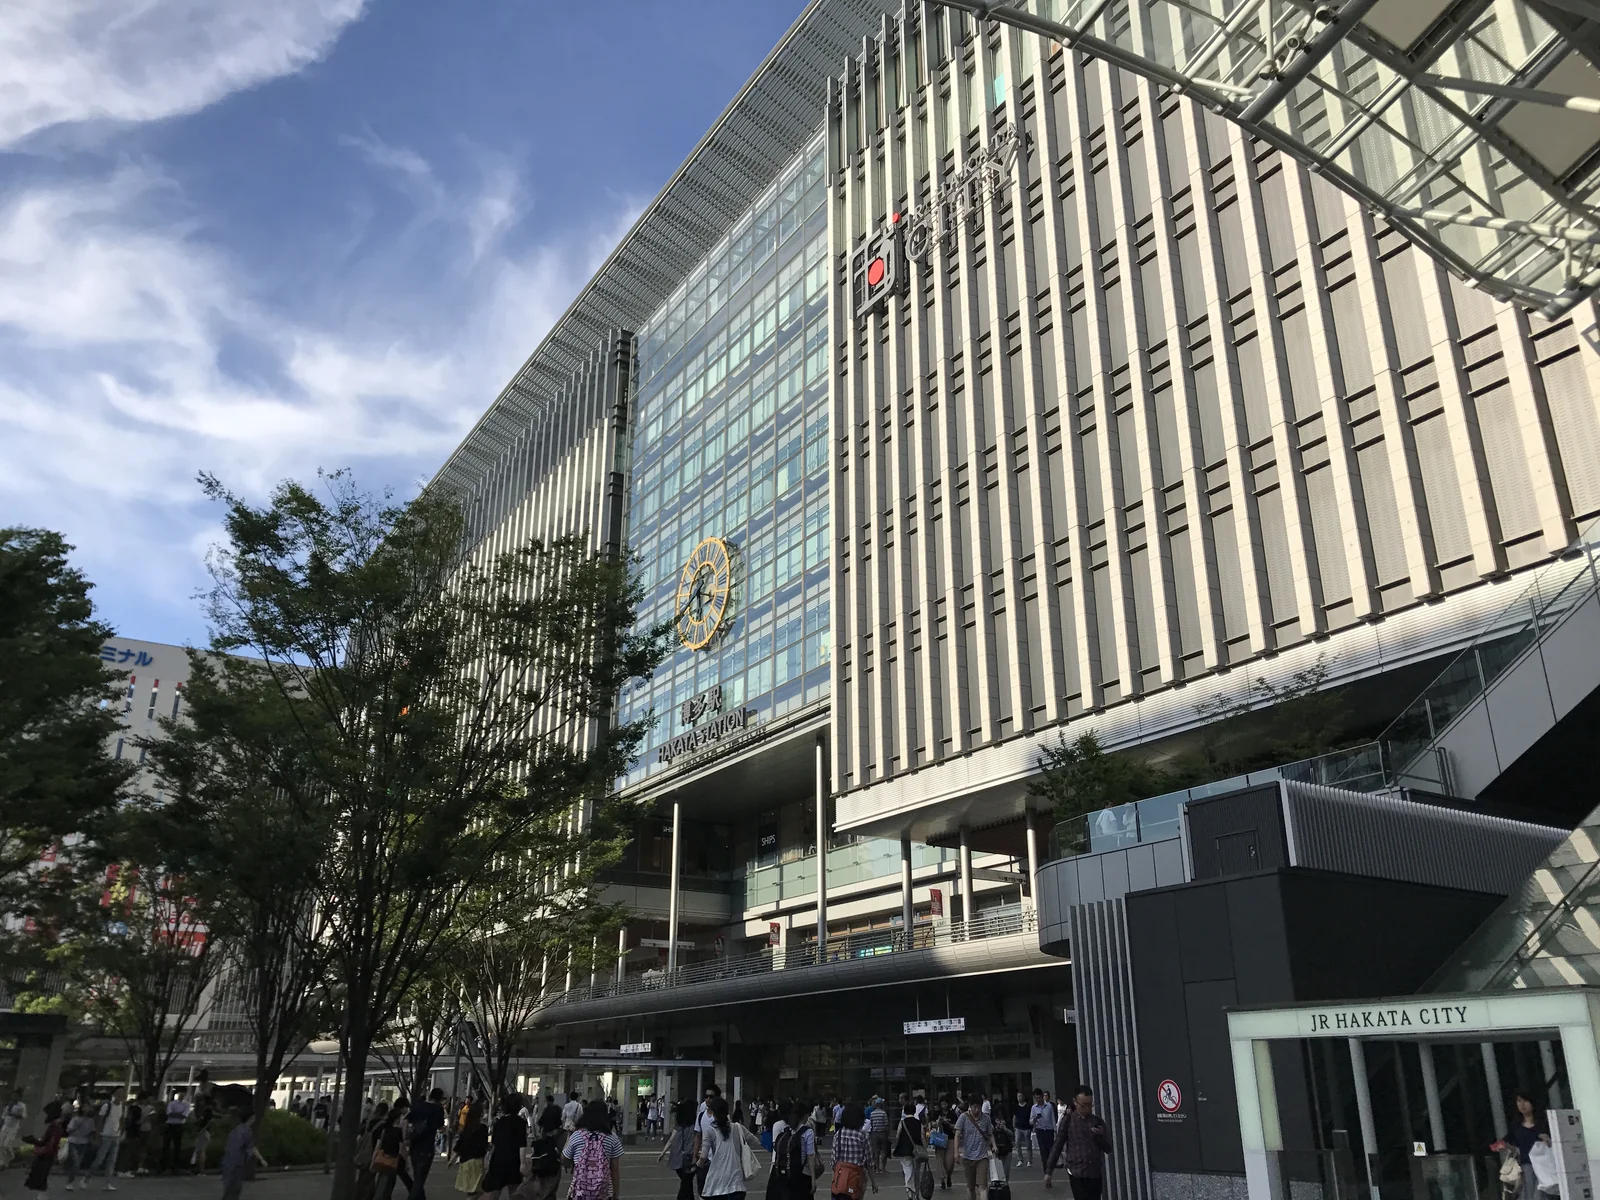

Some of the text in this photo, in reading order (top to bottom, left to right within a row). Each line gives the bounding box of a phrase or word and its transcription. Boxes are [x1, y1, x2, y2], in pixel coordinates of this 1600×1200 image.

[905, 121, 1018, 234] JR HAKATA
[905, 137, 1018, 261] CITY
[681, 685, 722, 726] 博多駅
[658, 706, 746, 763] HAKATA STATION
[761, 834, 776, 847] SHIPS
[1311, 1006, 1467, 1032] JR HAKATA CITY
